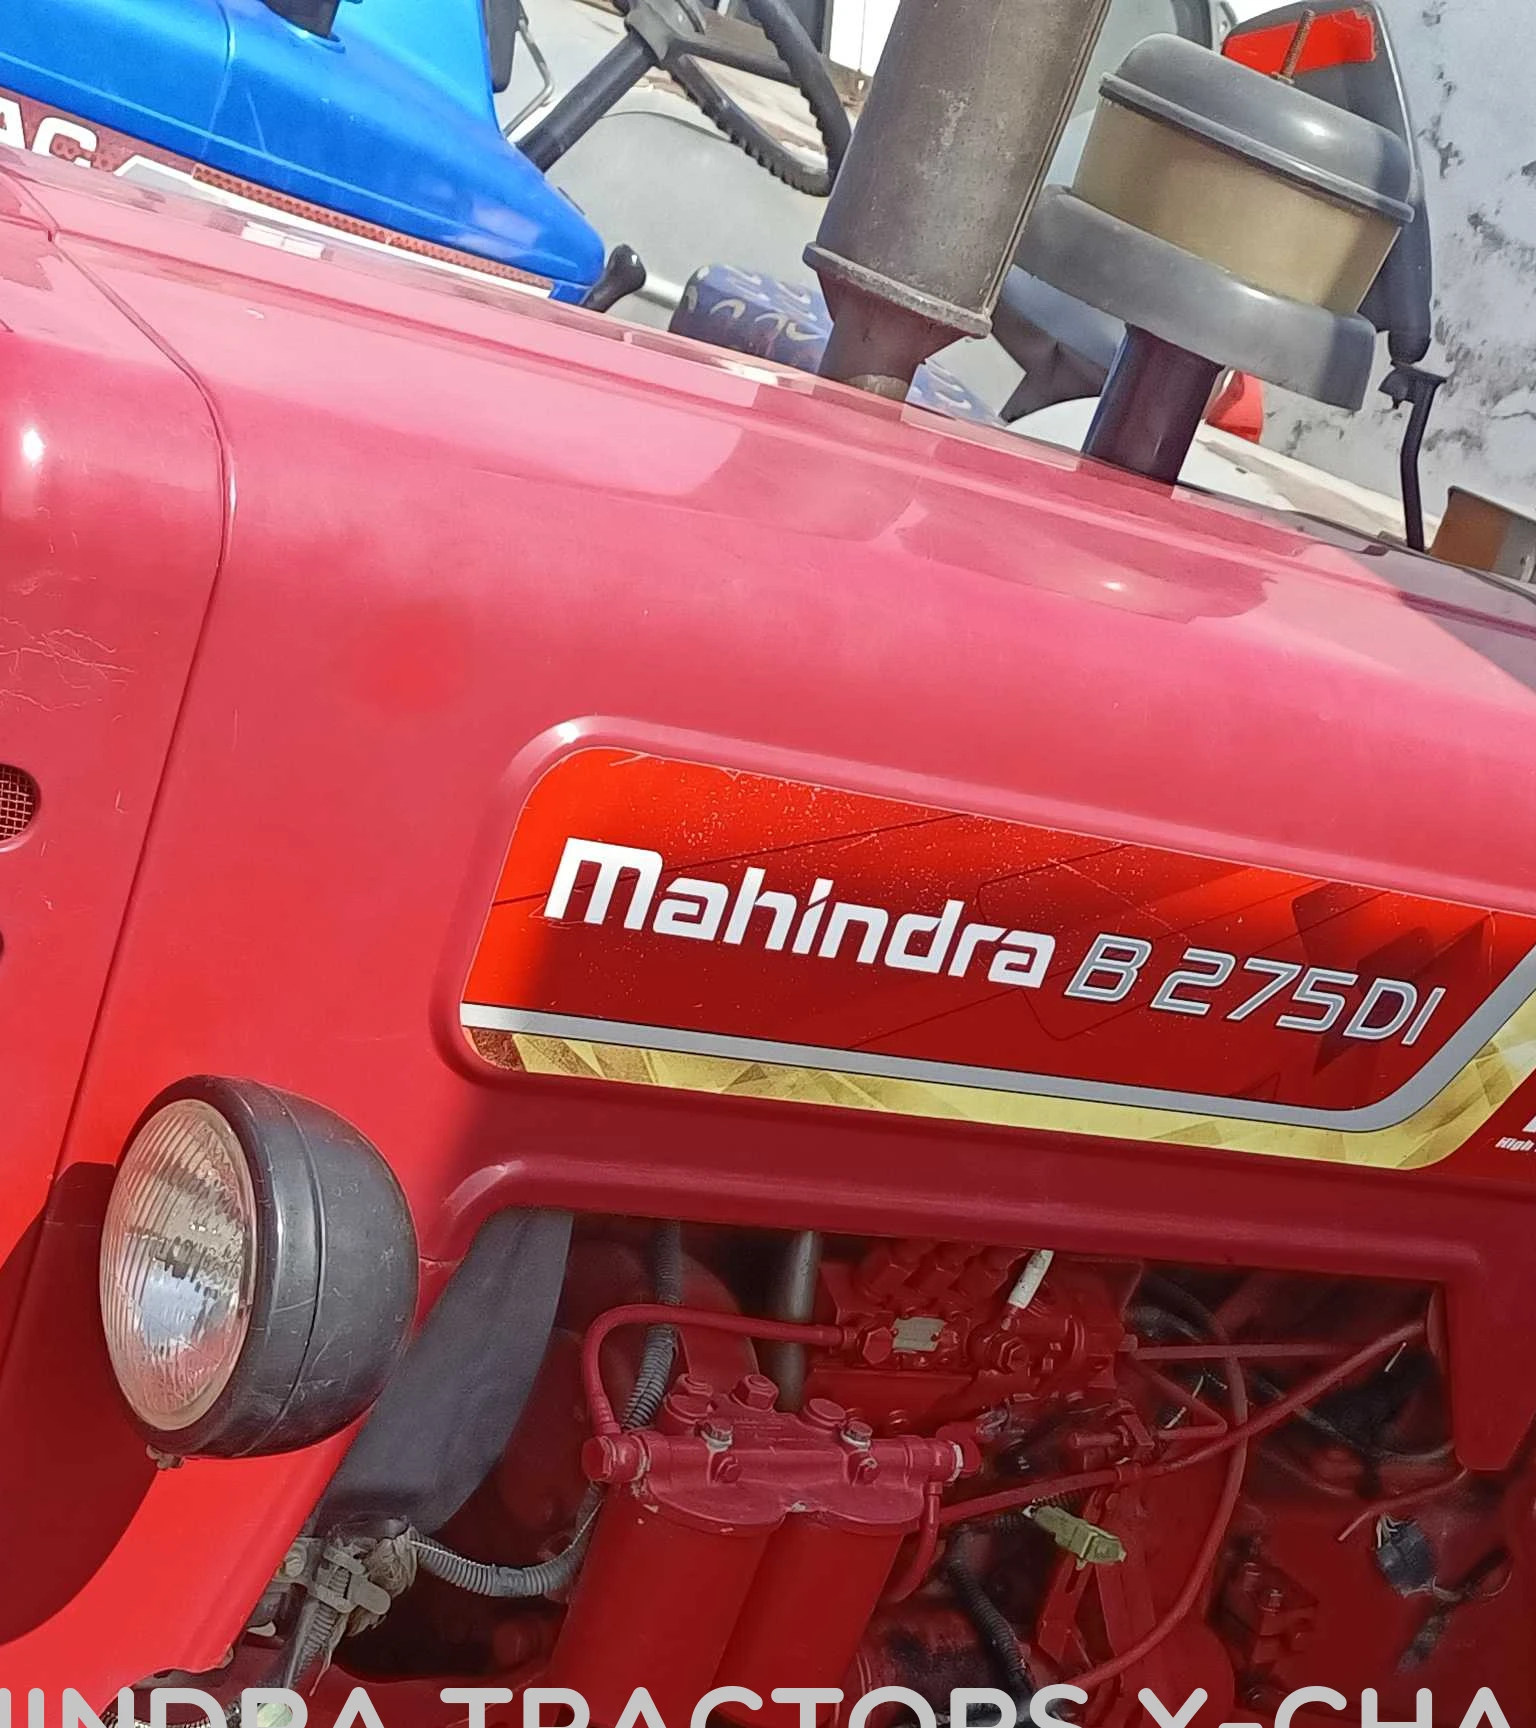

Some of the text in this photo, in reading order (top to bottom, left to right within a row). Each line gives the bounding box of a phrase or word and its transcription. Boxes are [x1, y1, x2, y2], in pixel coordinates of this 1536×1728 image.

[543, 836, 1448, 1049] Mahindra B 275DI
[1495, 1137, 1535, 1151] High
